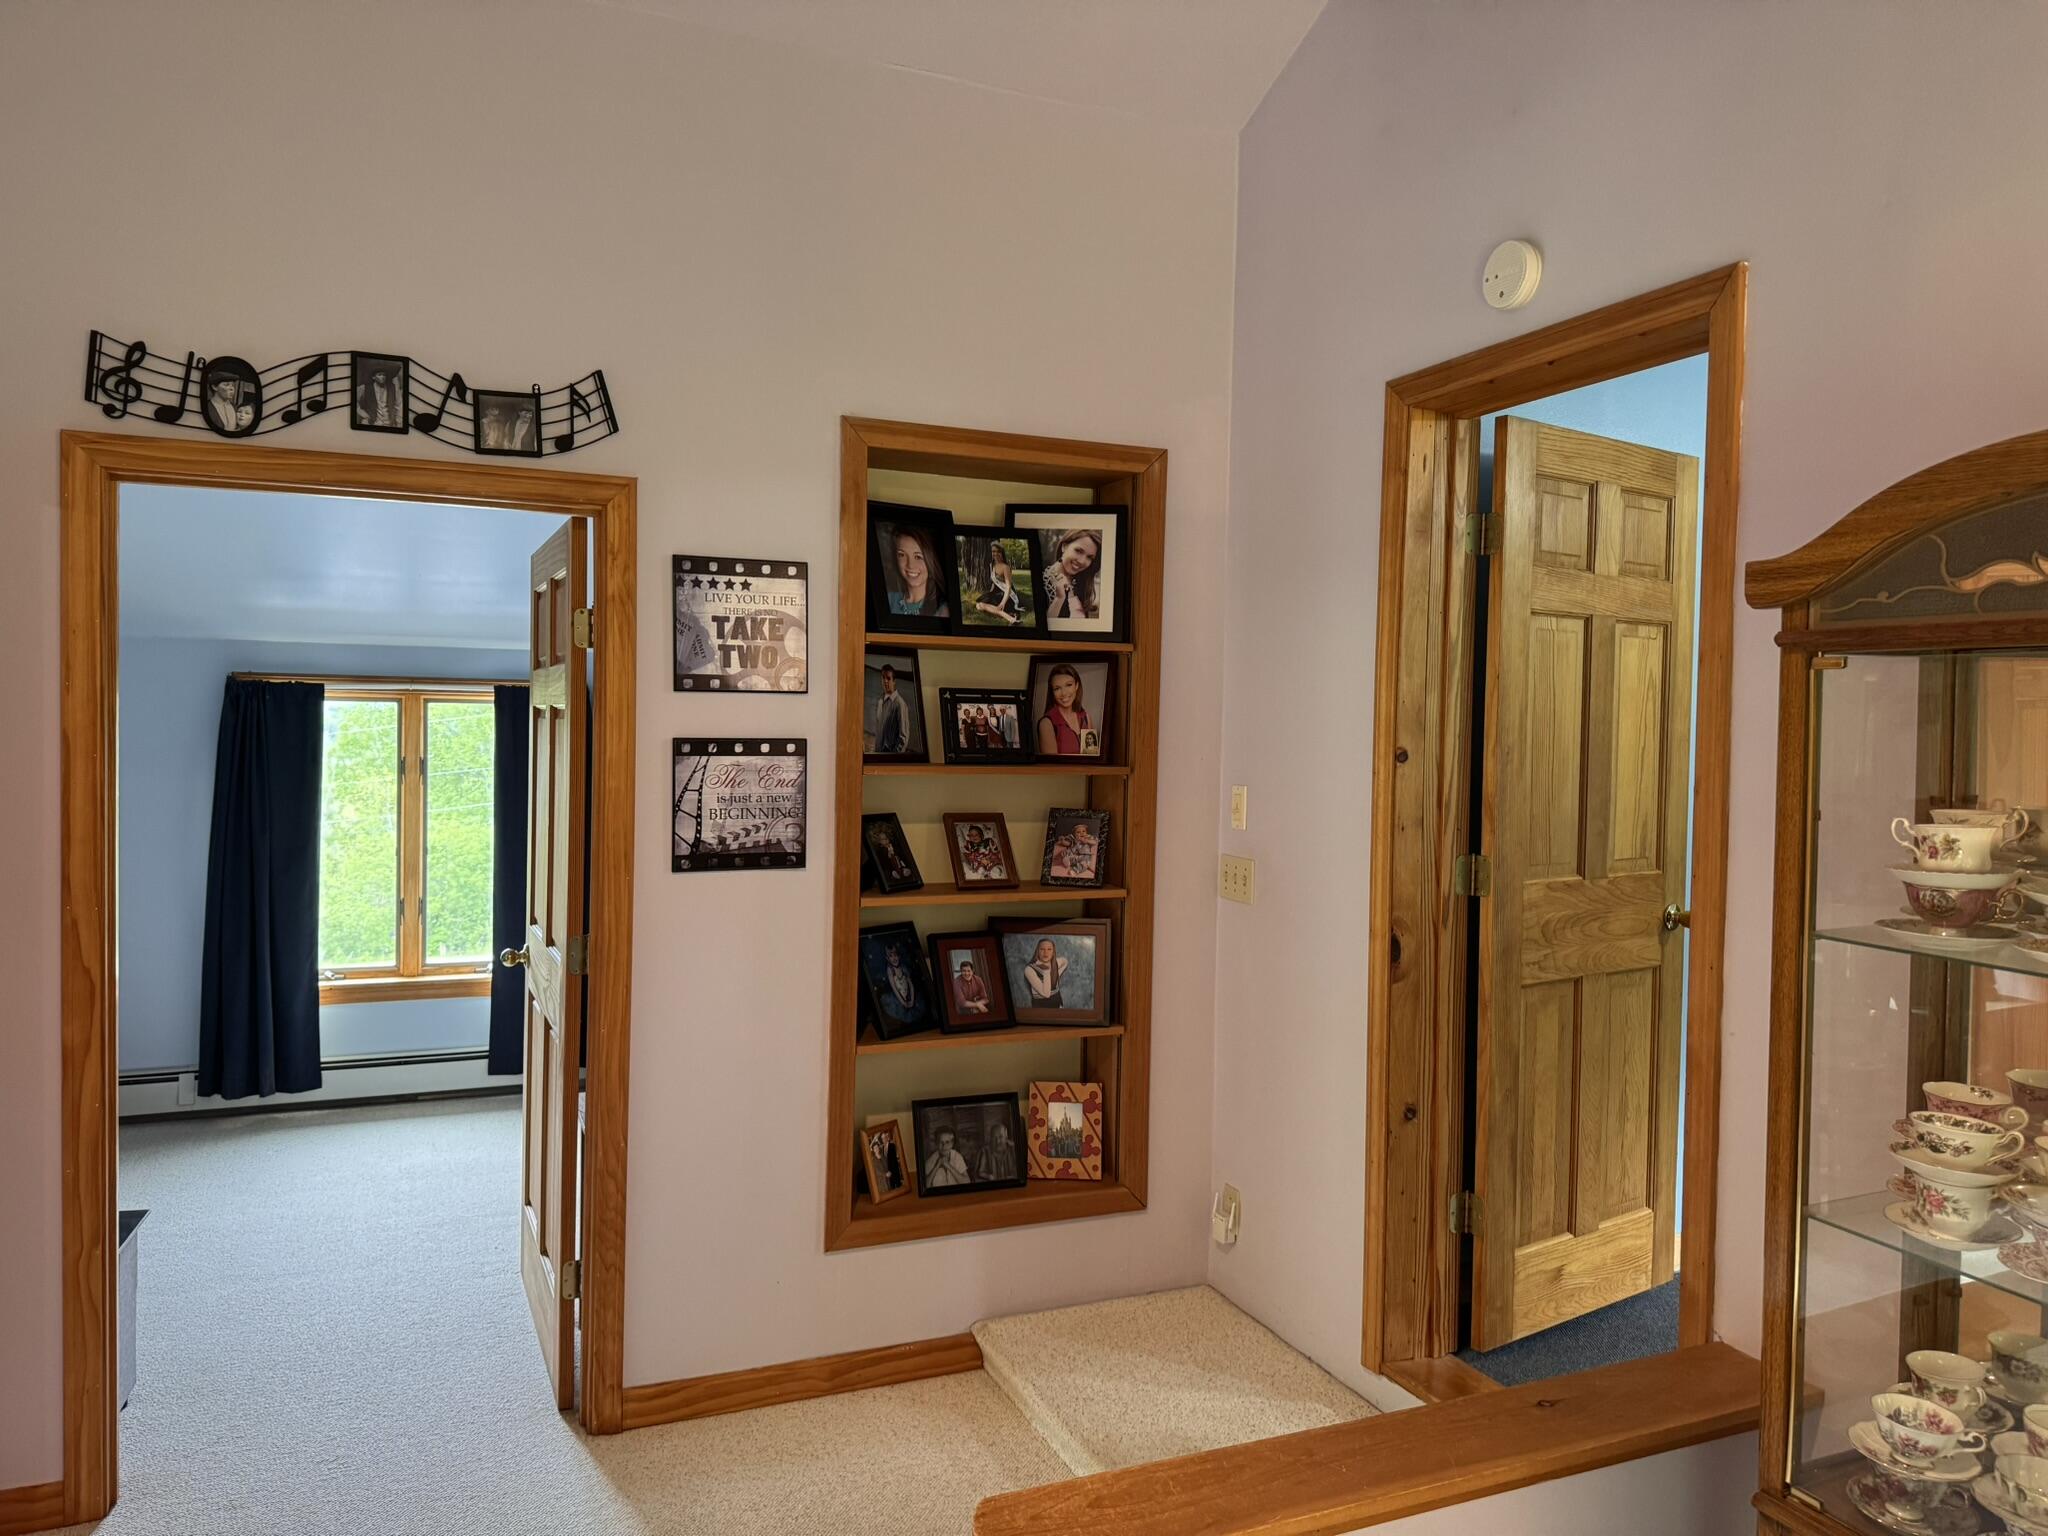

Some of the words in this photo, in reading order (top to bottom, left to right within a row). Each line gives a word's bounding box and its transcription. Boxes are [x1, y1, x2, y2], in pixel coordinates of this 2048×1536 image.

[704, 592, 732, 603] LIVE
[735, 594, 769, 606] YOUR
[711, 615, 784, 642] TAKE
[717, 643, 779, 670] TWO
[704, 763, 746, 789] The
[757, 763, 804, 790] End
[716, 792, 727, 804] is
[729, 792, 753, 806] just
[755, 794, 763, 803] a
[766, 794, 792, 803] new
[709, 806, 800, 821] BEGINNING
